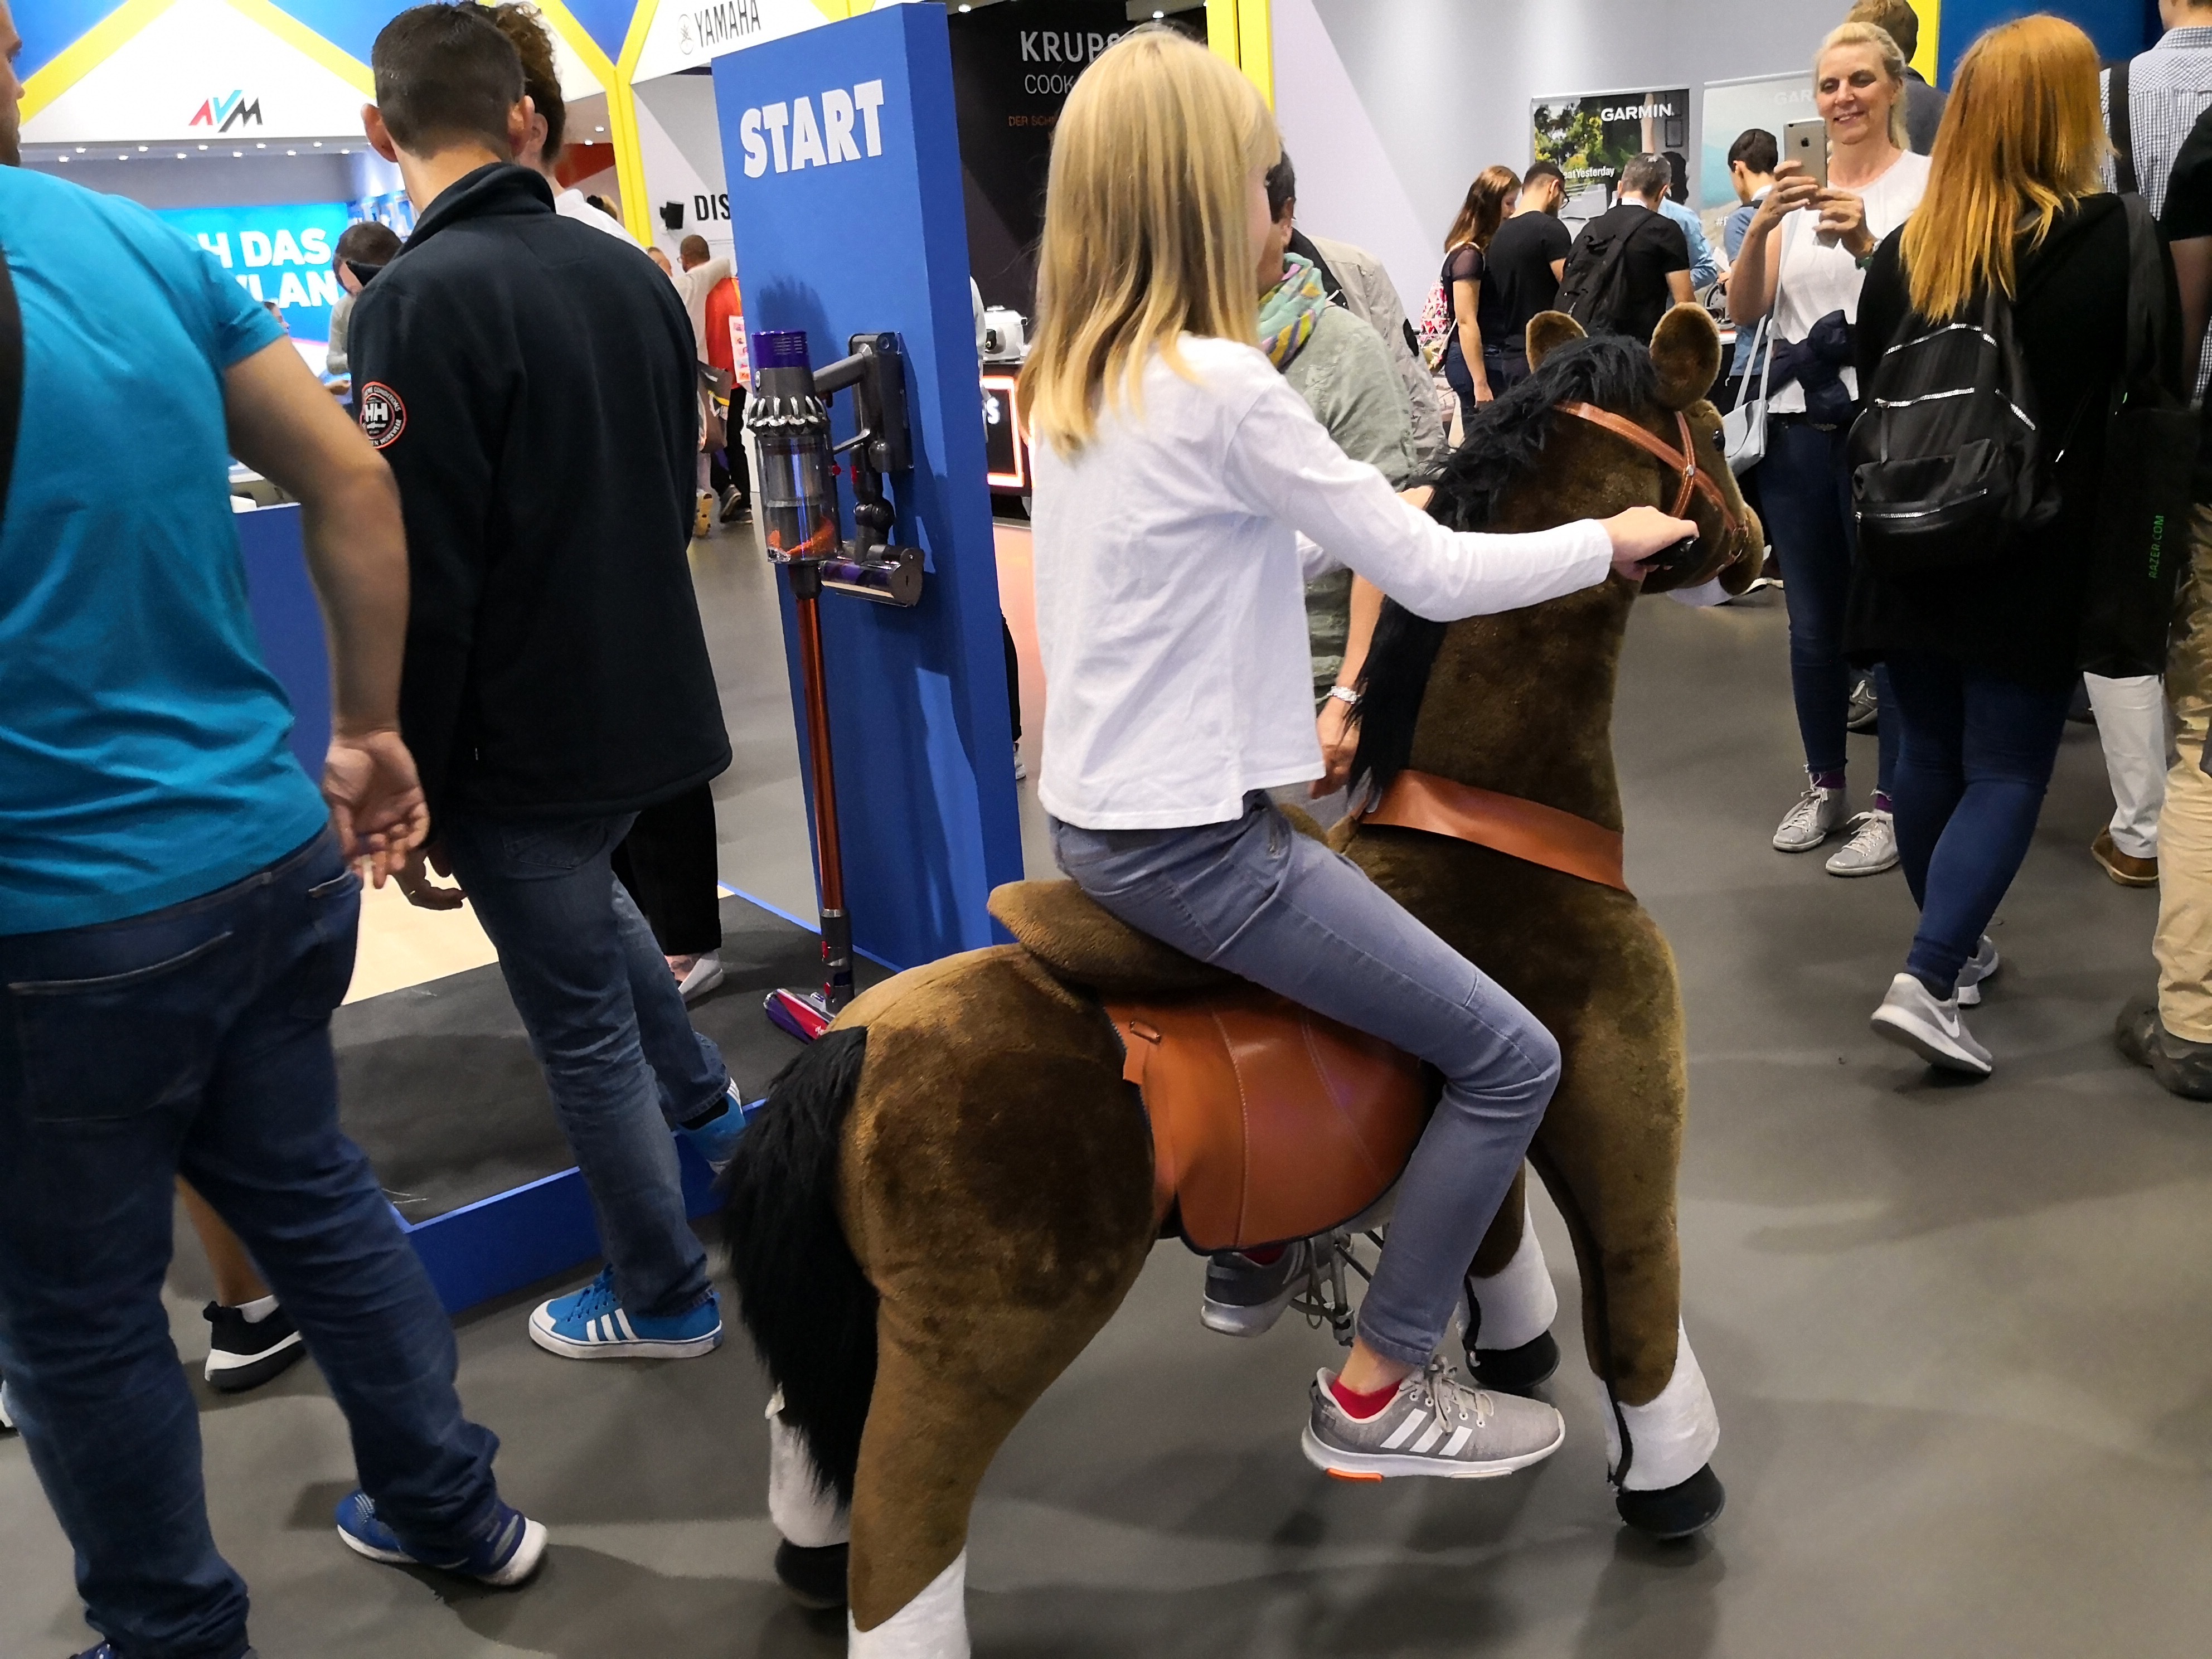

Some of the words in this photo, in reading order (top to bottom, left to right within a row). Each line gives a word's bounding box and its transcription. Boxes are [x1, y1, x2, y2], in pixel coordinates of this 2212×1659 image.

[695, 0, 761, 48] YAMAHA
[188, 90, 263, 133] AVM
[740, 79, 884, 178] START
[1600, 103, 1672, 122] GARMIN
[694, 193, 731, 221] DIS
[240, 228, 331, 267] DAS
[2148, 515, 2164, 579] RAZER.COM
